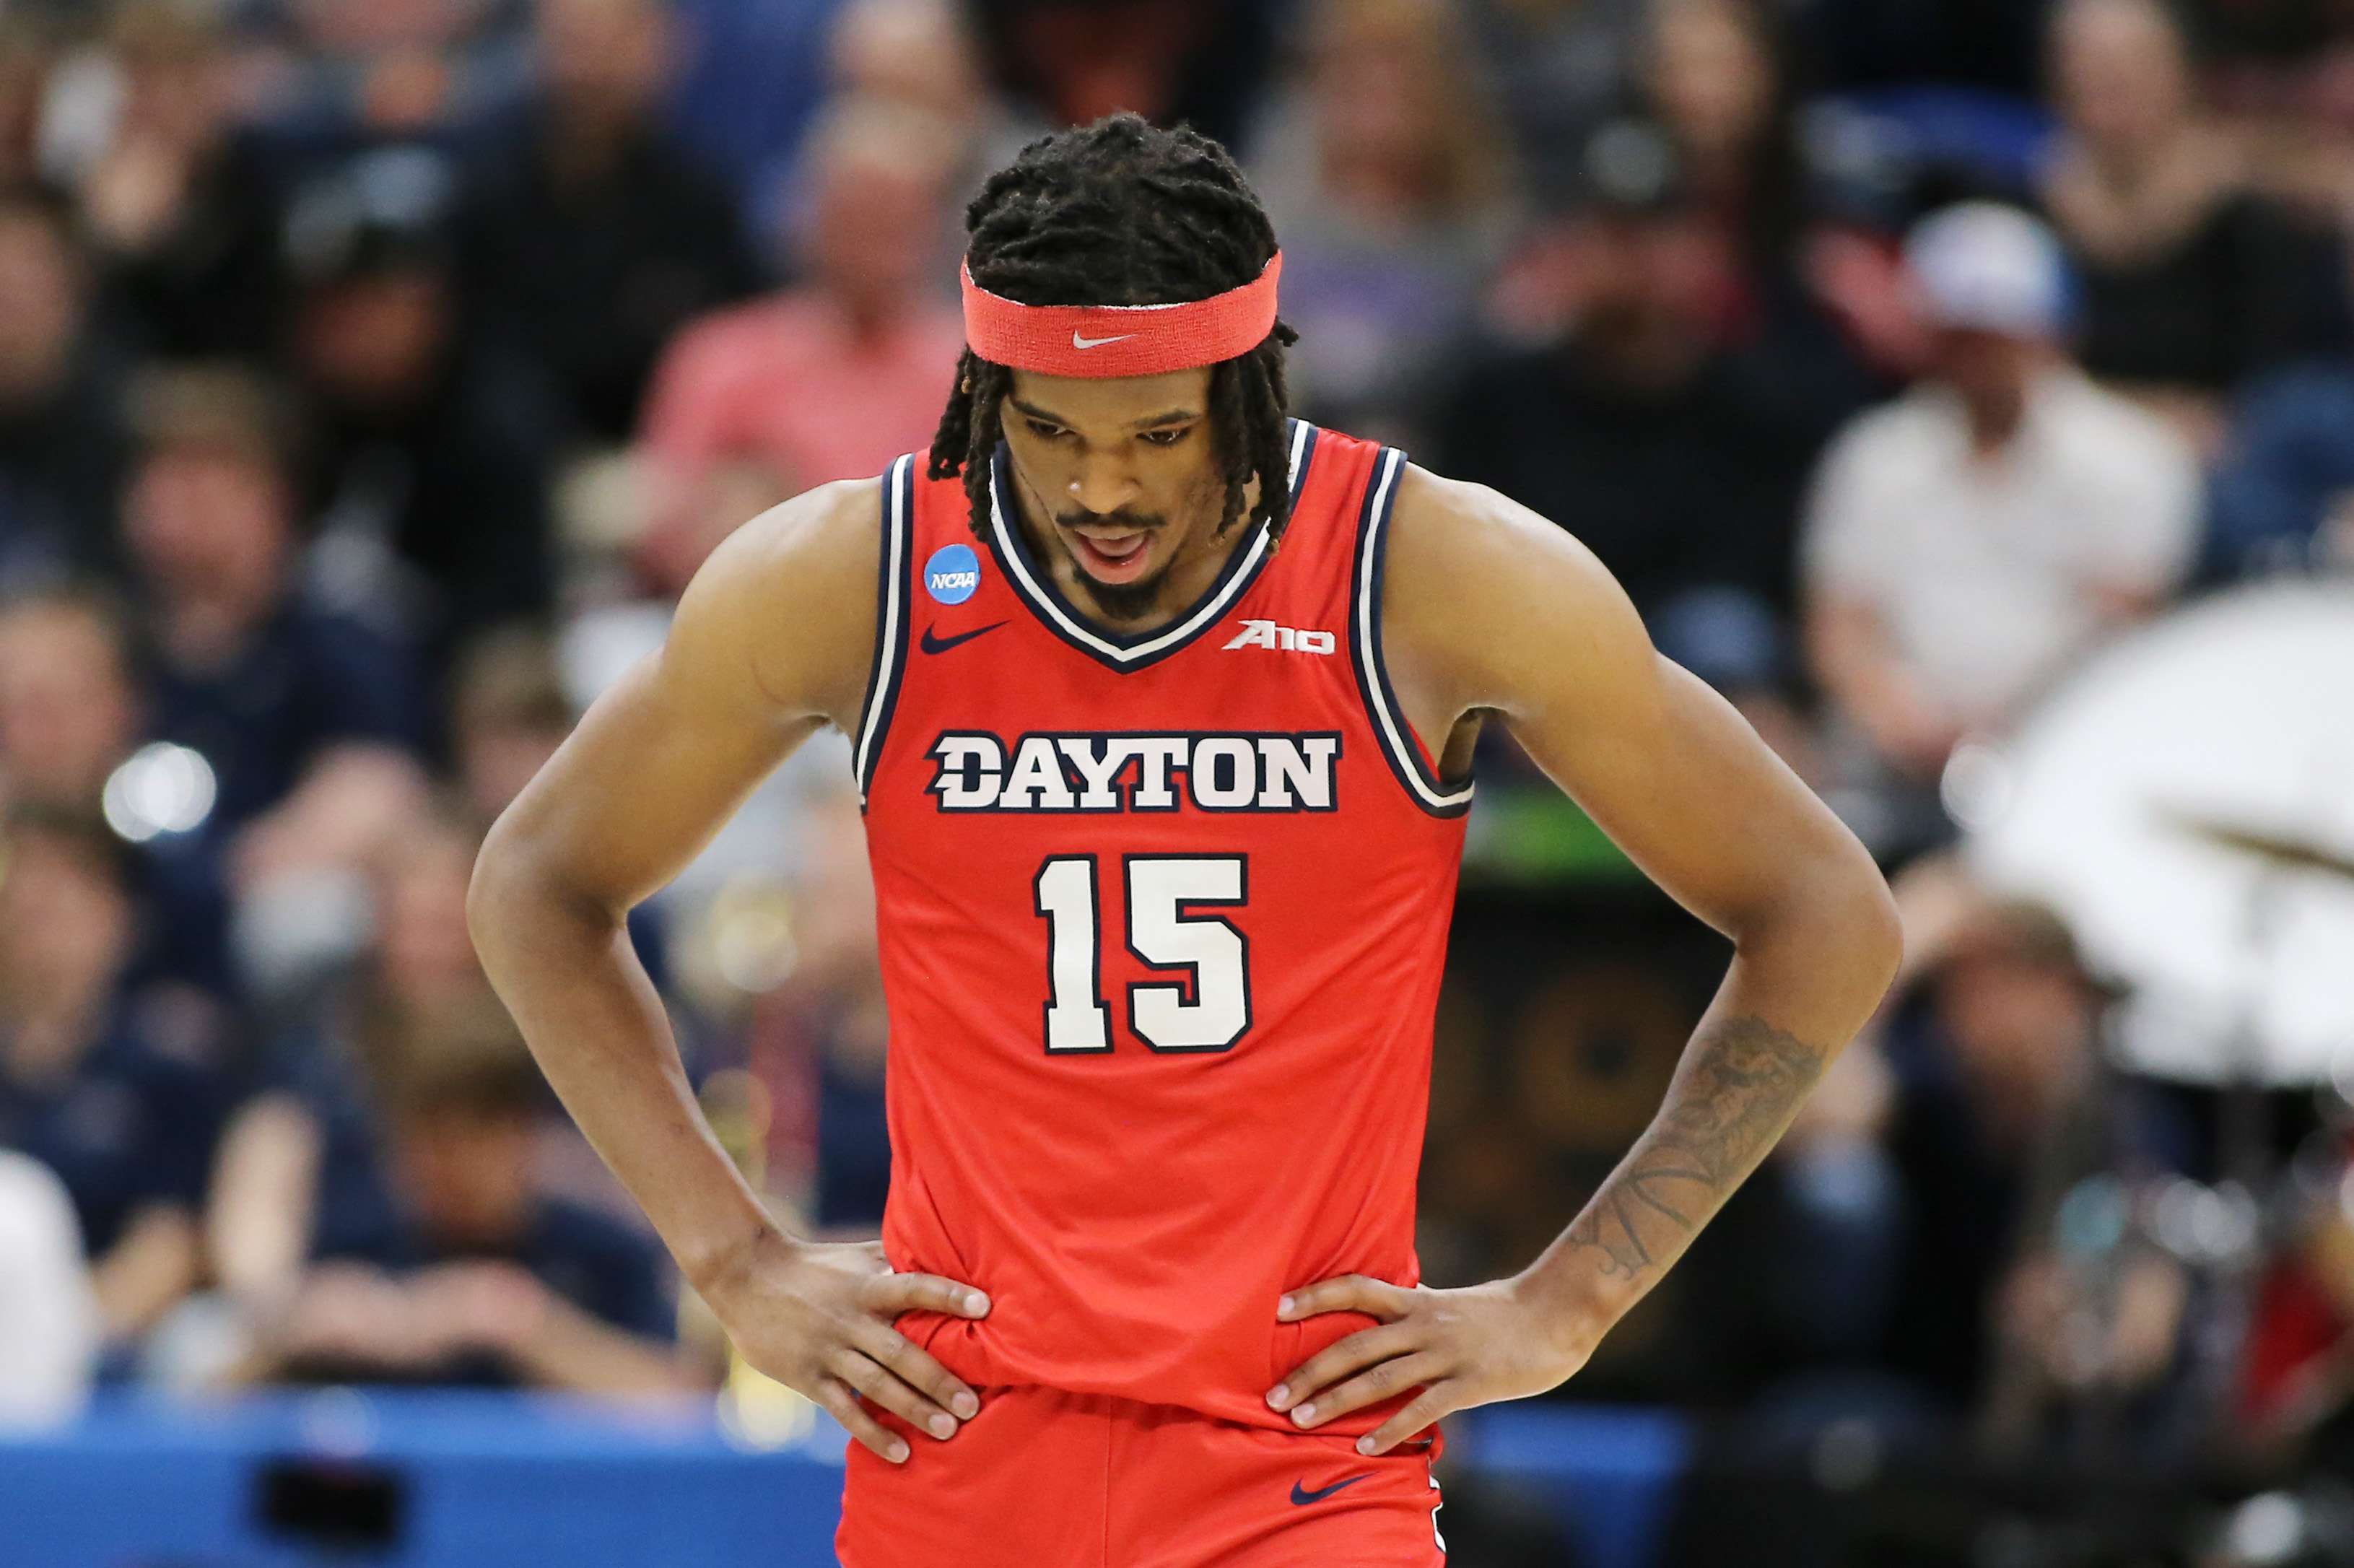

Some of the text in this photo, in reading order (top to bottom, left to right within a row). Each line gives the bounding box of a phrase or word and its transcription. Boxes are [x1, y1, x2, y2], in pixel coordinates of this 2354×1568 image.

[931, 572, 975, 589] NCAA
[1221, 619, 1335, 655] A10
[928, 731, 1340, 811] DAYTON
[1033, 853, 1252, 1054] 15
